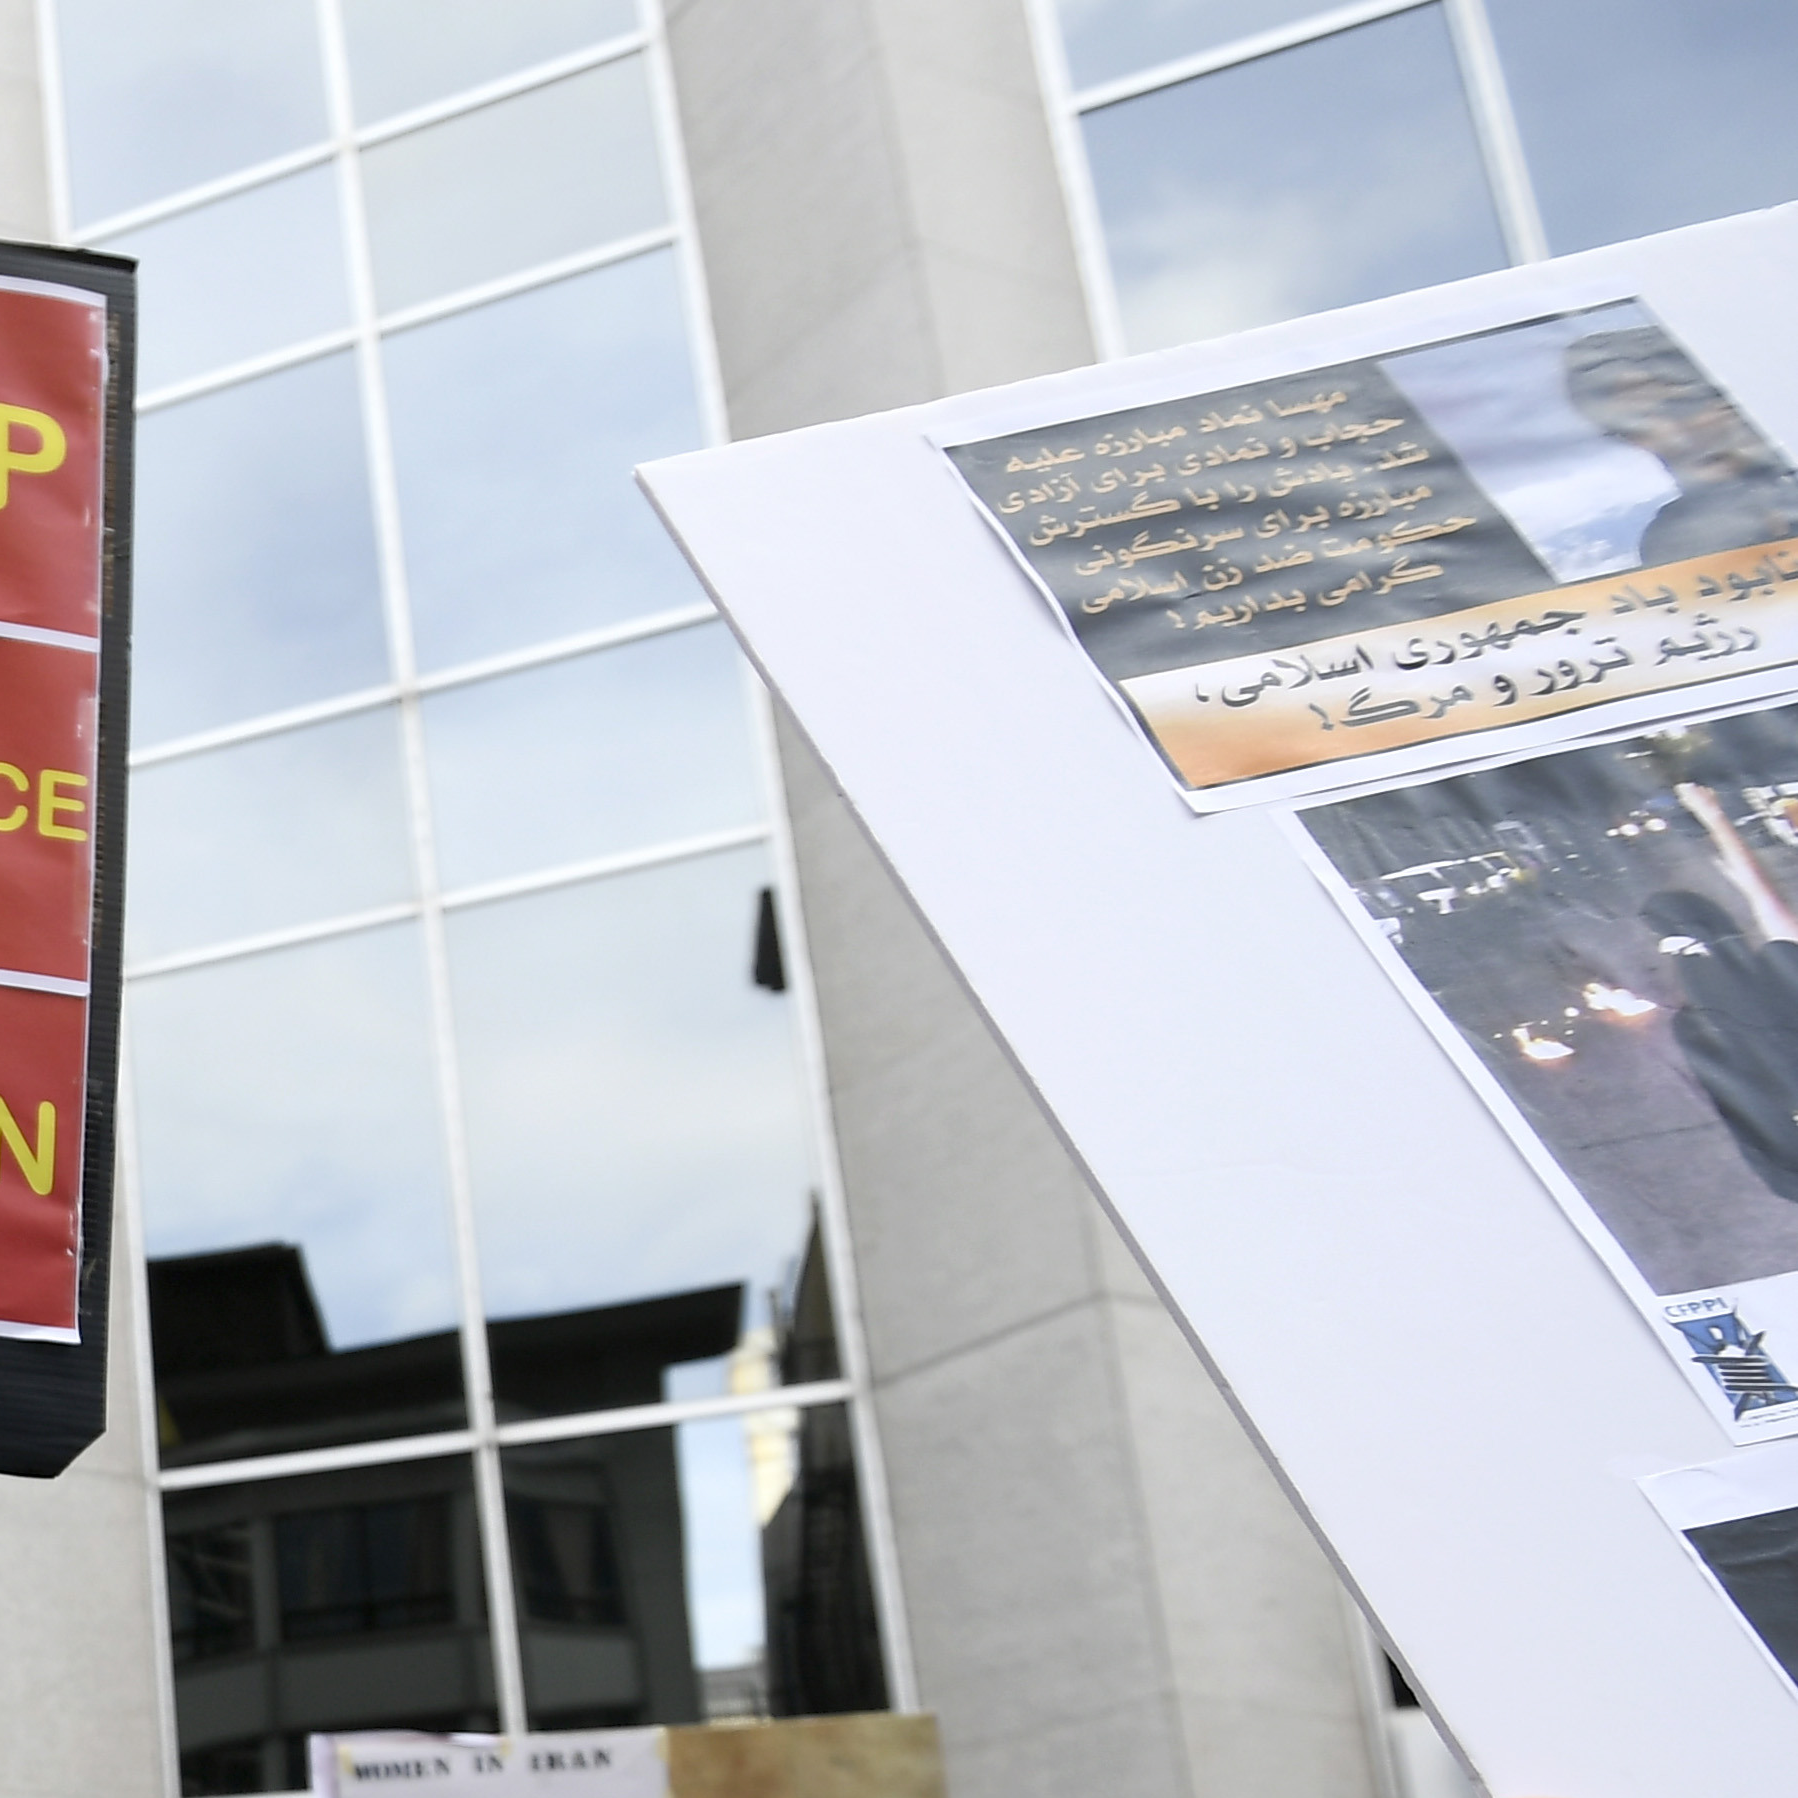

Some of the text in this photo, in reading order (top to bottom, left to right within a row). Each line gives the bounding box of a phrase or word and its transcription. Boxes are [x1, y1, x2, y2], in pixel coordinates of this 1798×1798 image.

[1006, 391, 1347, 473] مهسا نماد مبارزه علیه
[999, 418, 1405, 514] حجاب و نمادی برای آزادی
[1224, 481, 1258, 504] را
[1267, 462, 1353, 497] یادش
[1029, 491, 1182, 546] گسترش
[1184, 487, 1220, 511] با
[1075, 485, 1433, 576] مبارزه برای سرنگونی
[1082, 516, 1477, 615] حکومت ضد زن اسلامی
[1318, 555, 1444, 607] گرامی
[1611, 583, 1679, 615] باد
[1394, 610, 1587, 671] جمهوری
[1529, 637, 1635, 696] ترور
[1492, 674, 1519, 707] و
[352, 1740, 612, 1783] WOMEN IN IRAN
